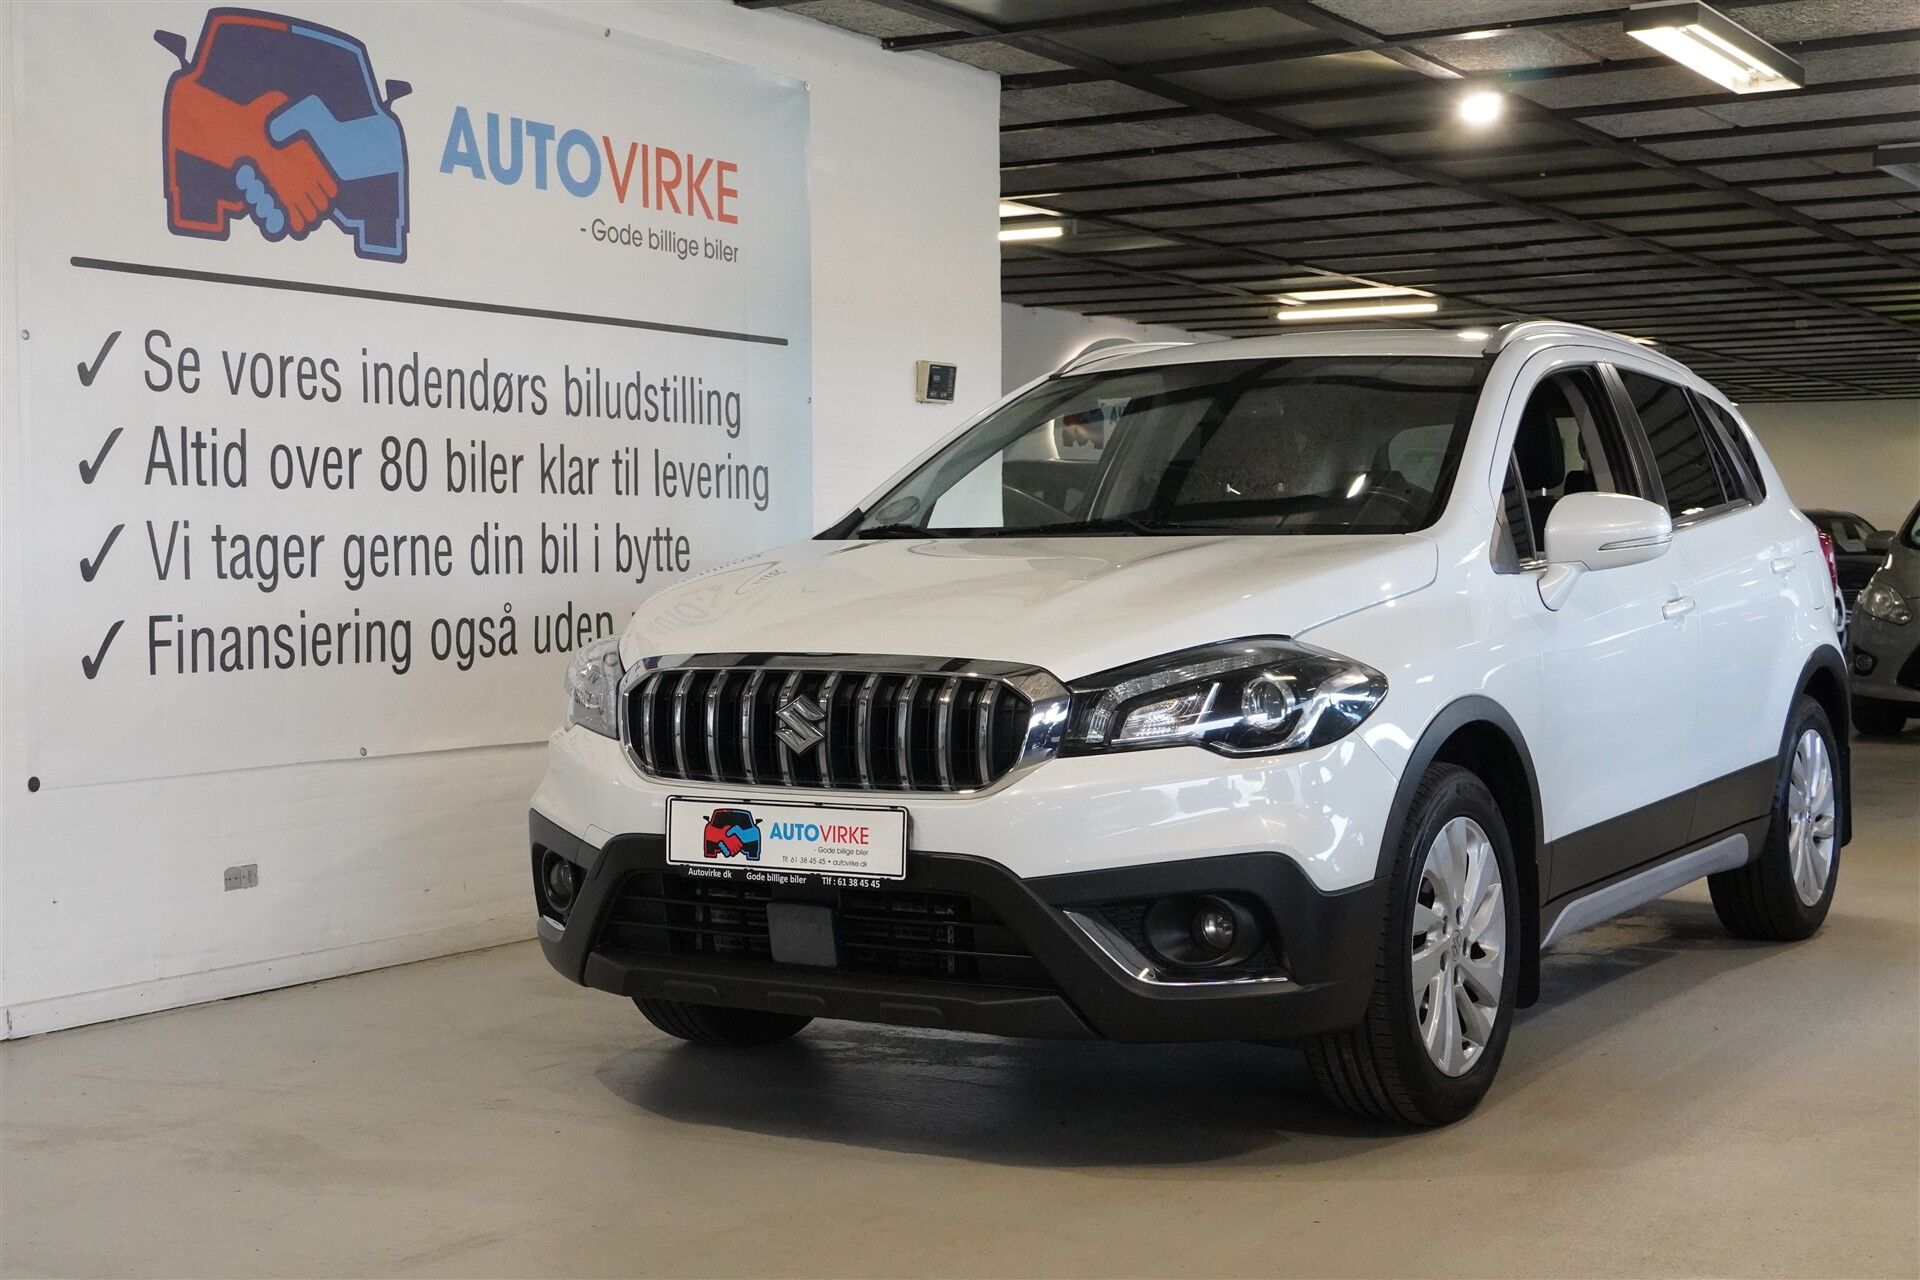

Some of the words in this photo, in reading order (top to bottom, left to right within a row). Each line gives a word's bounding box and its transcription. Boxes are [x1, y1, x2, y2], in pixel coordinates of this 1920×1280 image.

[440, 106, 738, 225] AUTOVIRKE
[591, 218, 643, 247] Gode
[649, 227, 699, 260] billige
[704, 237, 739, 263] biler
[144, 329, 201, 394] Se
[222, 350, 342, 403] vores
[361, 347, 548, 416] indendørs
[564, 364, 741, 439] biludstilling
[144, 425, 247, 489] Altid
[270, 443, 363, 491] over
[380, 435, 428, 493] 80
[445, 437, 525, 495] biler
[539, 442, 600, 496] klar
[611, 446, 639, 497] til
[654, 448, 769, 512] levering
[145, 519, 191, 581] Vi
[211, 524, 326, 594] tager
[343, 534, 453, 592] gerne
[470, 521, 524, 577] din
[541, 521, 578, 575] bil
[594, 522, 600, 573] i
[615, 522, 691, 585] bytte
[148, 607, 412, 676] Finansiering
[430, 601, 519, 672] også
[533, 600, 614, 655] uden
[769, 822, 869, 845] AUTOVIRKE
[809, 857, 817, 865] 45
[818, 846, 836, 854] Gode
[837, 848, 855, 856] billige
[856, 848, 869, 856] biler
[746, 872, 766, 881] Gode
[767, 873, 788, 884] billige
[790, 875, 807, 883] biler
[837, 878, 846, 886] 61
[849, 878, 858, 887] 38
[860, 879, 868, 887] 45
[871, 880, 880, 888] 45
